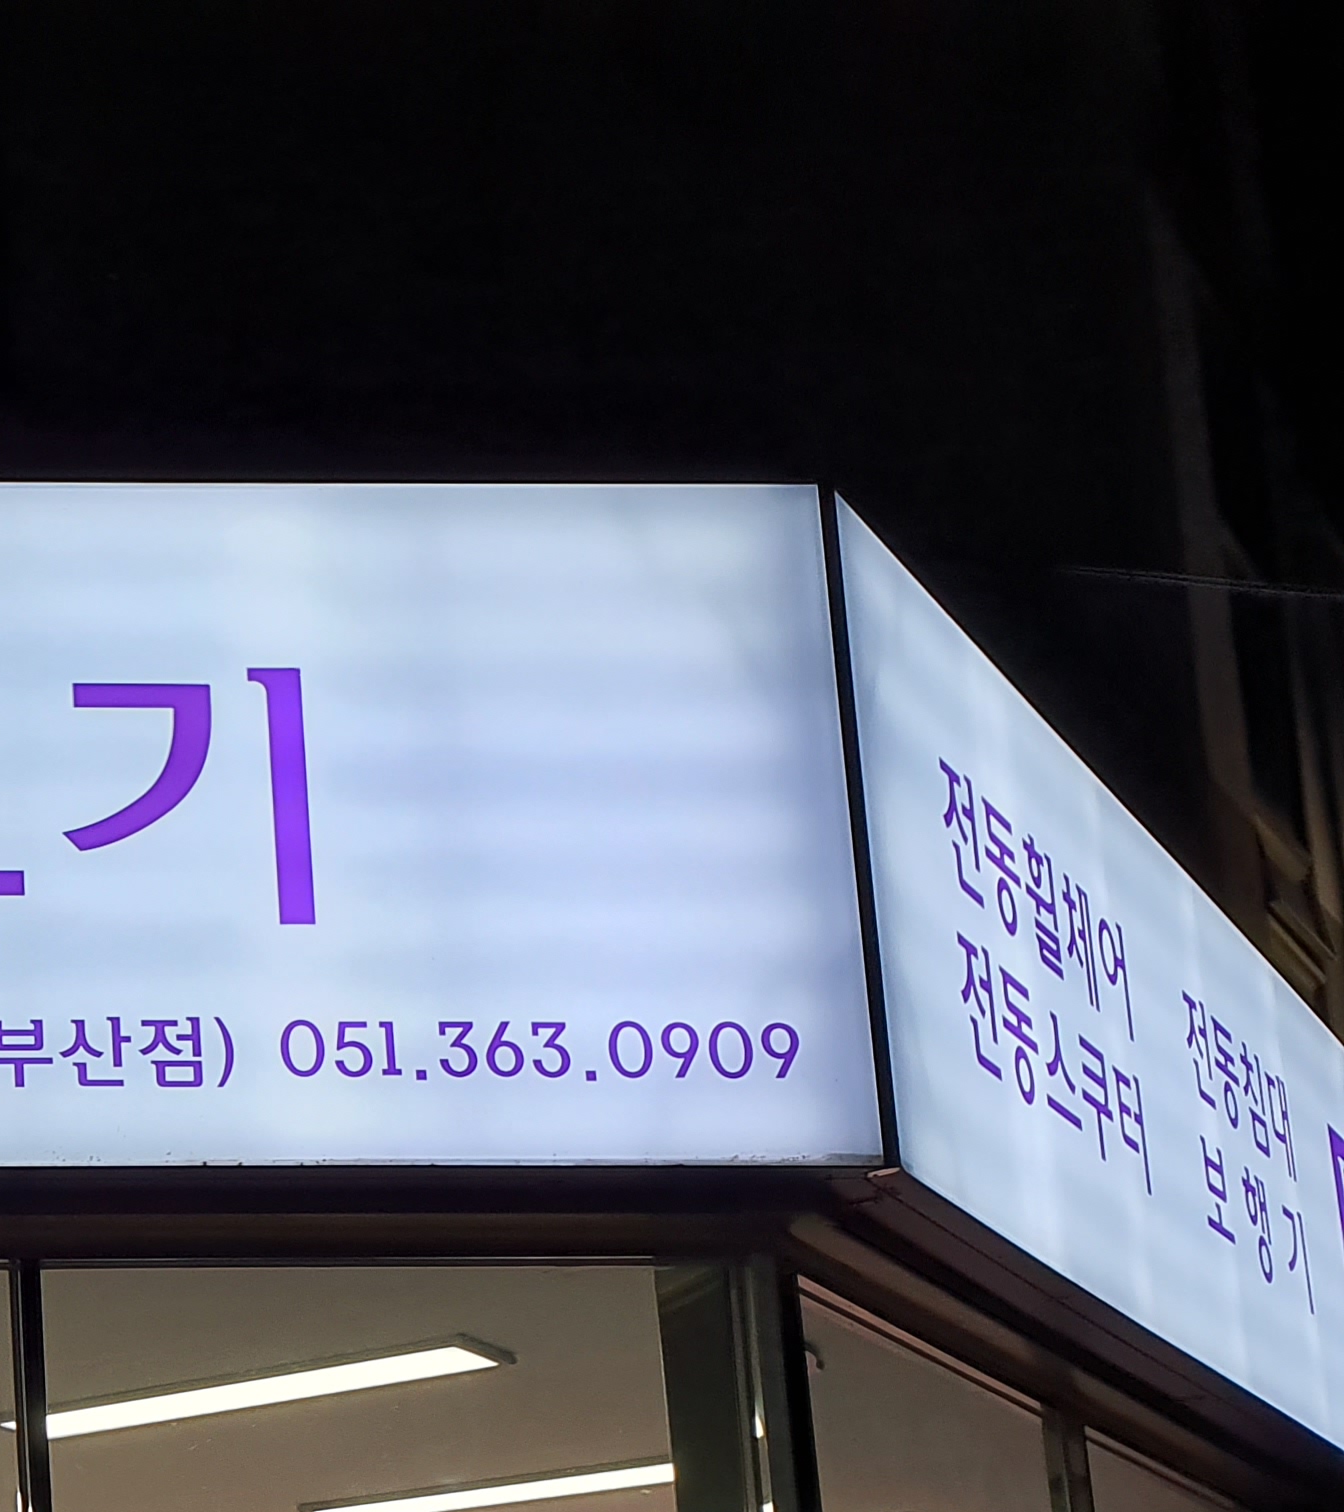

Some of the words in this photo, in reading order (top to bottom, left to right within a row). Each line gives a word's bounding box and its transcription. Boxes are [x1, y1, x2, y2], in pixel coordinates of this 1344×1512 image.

[939, 757, 1135, 1041] 전동휠체어
[280, 1018, 803, 1086] 051.363.0909
[956, 931, 1152, 1196] 전동스쿠터
[1182, 990, 1298, 1183] 전동침대
[1199, 1135, 1315, 1316] 보행기
